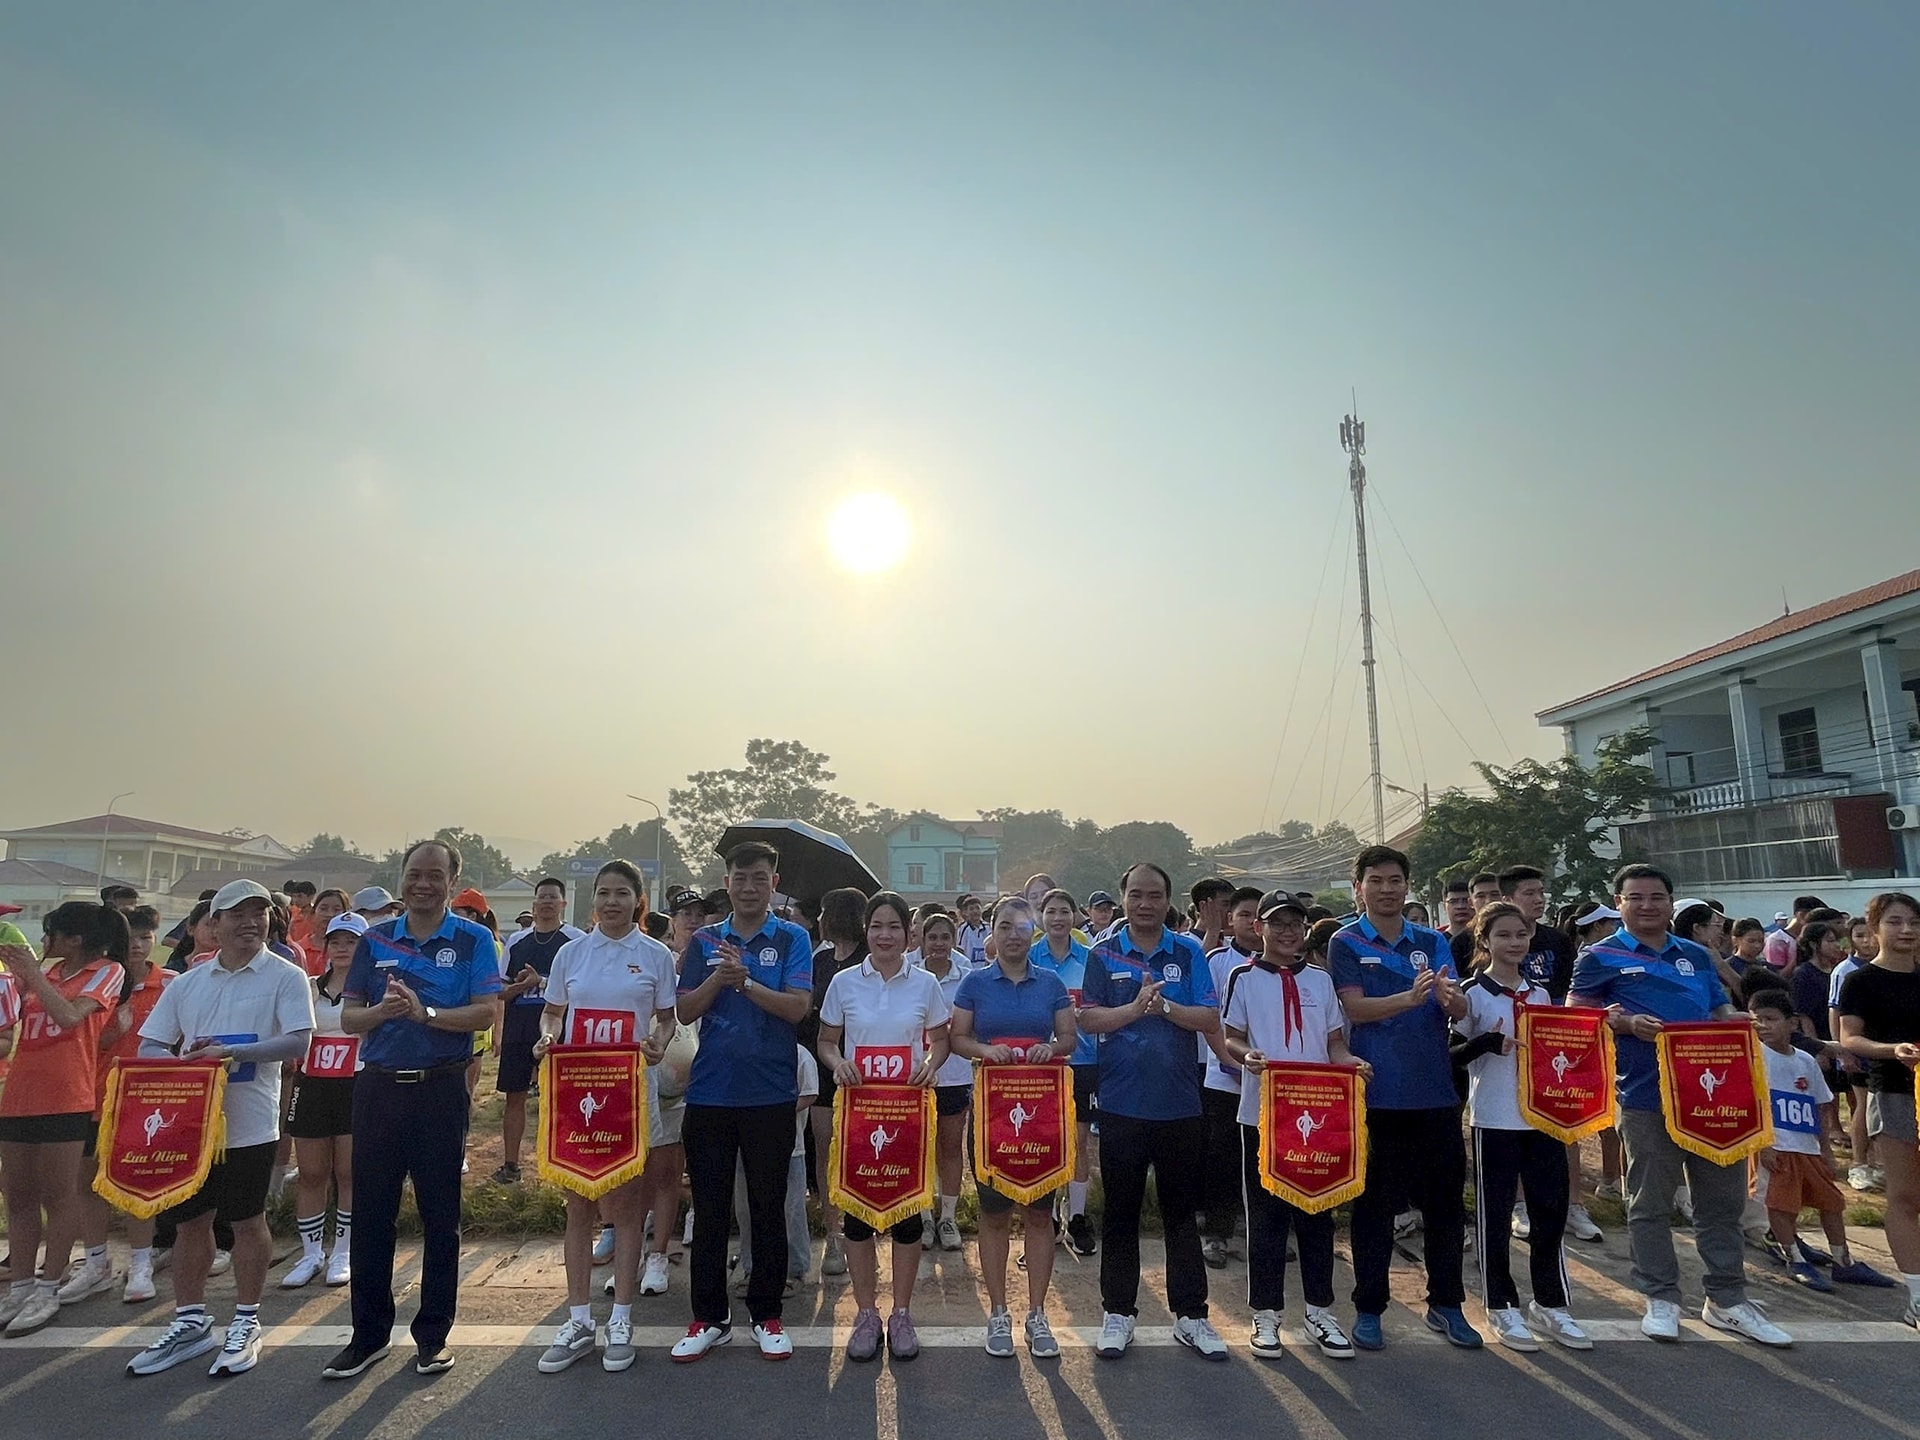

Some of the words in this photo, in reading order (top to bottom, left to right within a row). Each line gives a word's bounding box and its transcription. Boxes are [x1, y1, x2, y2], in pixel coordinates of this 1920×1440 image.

[583, 1018, 623, 1044] 141
[313, 1045, 350, 1069] 197
[1542, 1085, 1565, 1098] Lưu
[1567, 1087, 1594, 1101] Niệm
[1690, 1106, 1714, 1117] Lưu
[1717, 1105, 1748, 1120] Niệm
[1776, 1098, 1814, 1127] 164
[565, 1130, 589, 1143] Lưu
[591, 1130, 622, 1145] Niệm
[996, 1141, 1019, 1153] Lưu
[1021, 1142, 1050, 1156] Niệm
[120, 1151, 148, 1163] Lưu
[150, 1150, 188, 1165] Niệm
[1284, 1149, 1307, 1162] Lưu
[1310, 1150, 1340, 1166] Niệm
[856, 1164, 878, 1176] Lưu
[881, 1164, 910, 1178] Niệm
